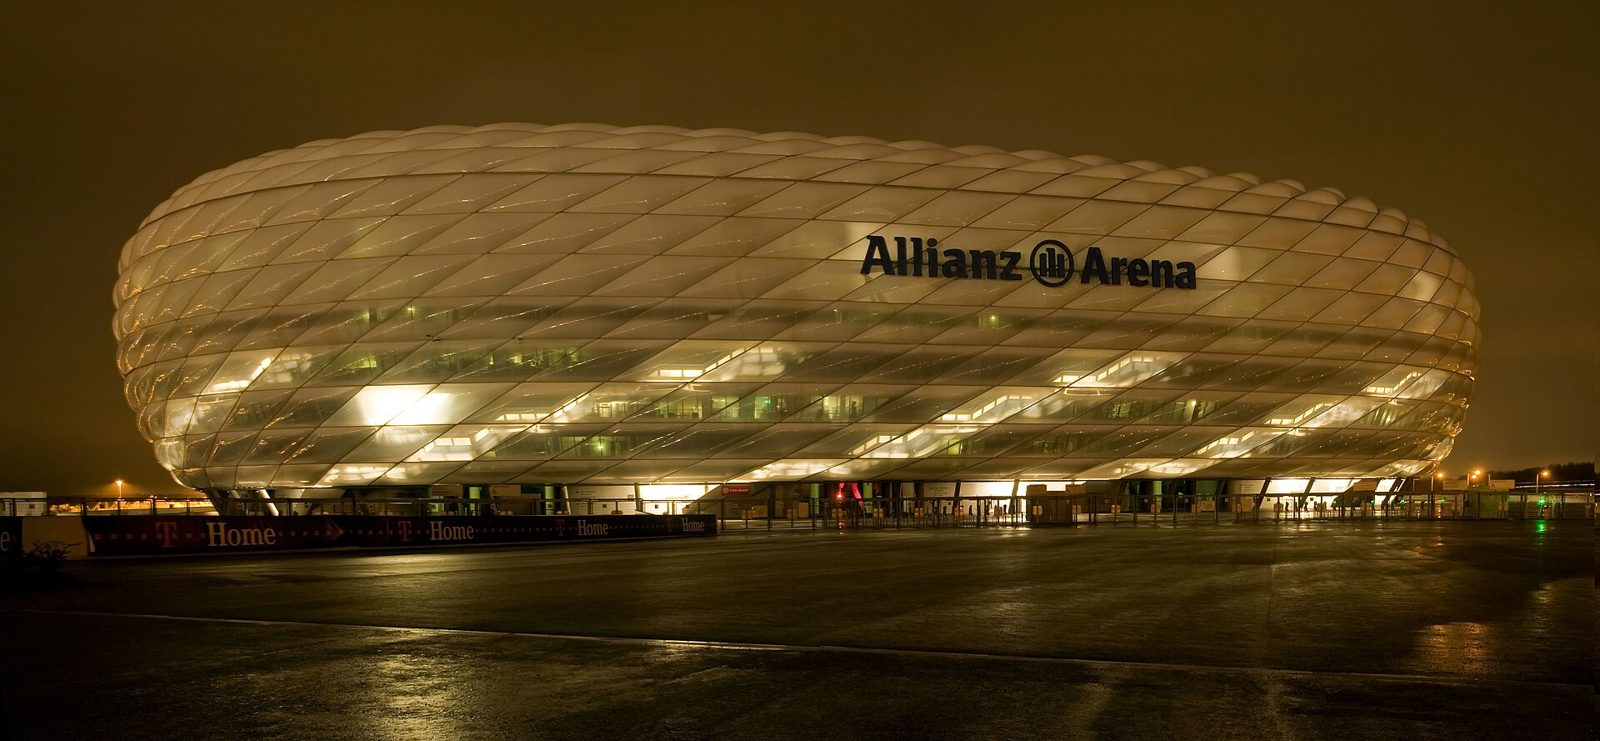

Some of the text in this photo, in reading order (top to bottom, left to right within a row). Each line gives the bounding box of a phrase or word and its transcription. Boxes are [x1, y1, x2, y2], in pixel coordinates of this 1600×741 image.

[860, 235, 1196, 290] Allianz Arena
[155, 521, 277, 548] T Home
[398, 520, 475, 541] T Home
[577, 519, 609, 536] Home
[682, 517, 705, 532] Home
